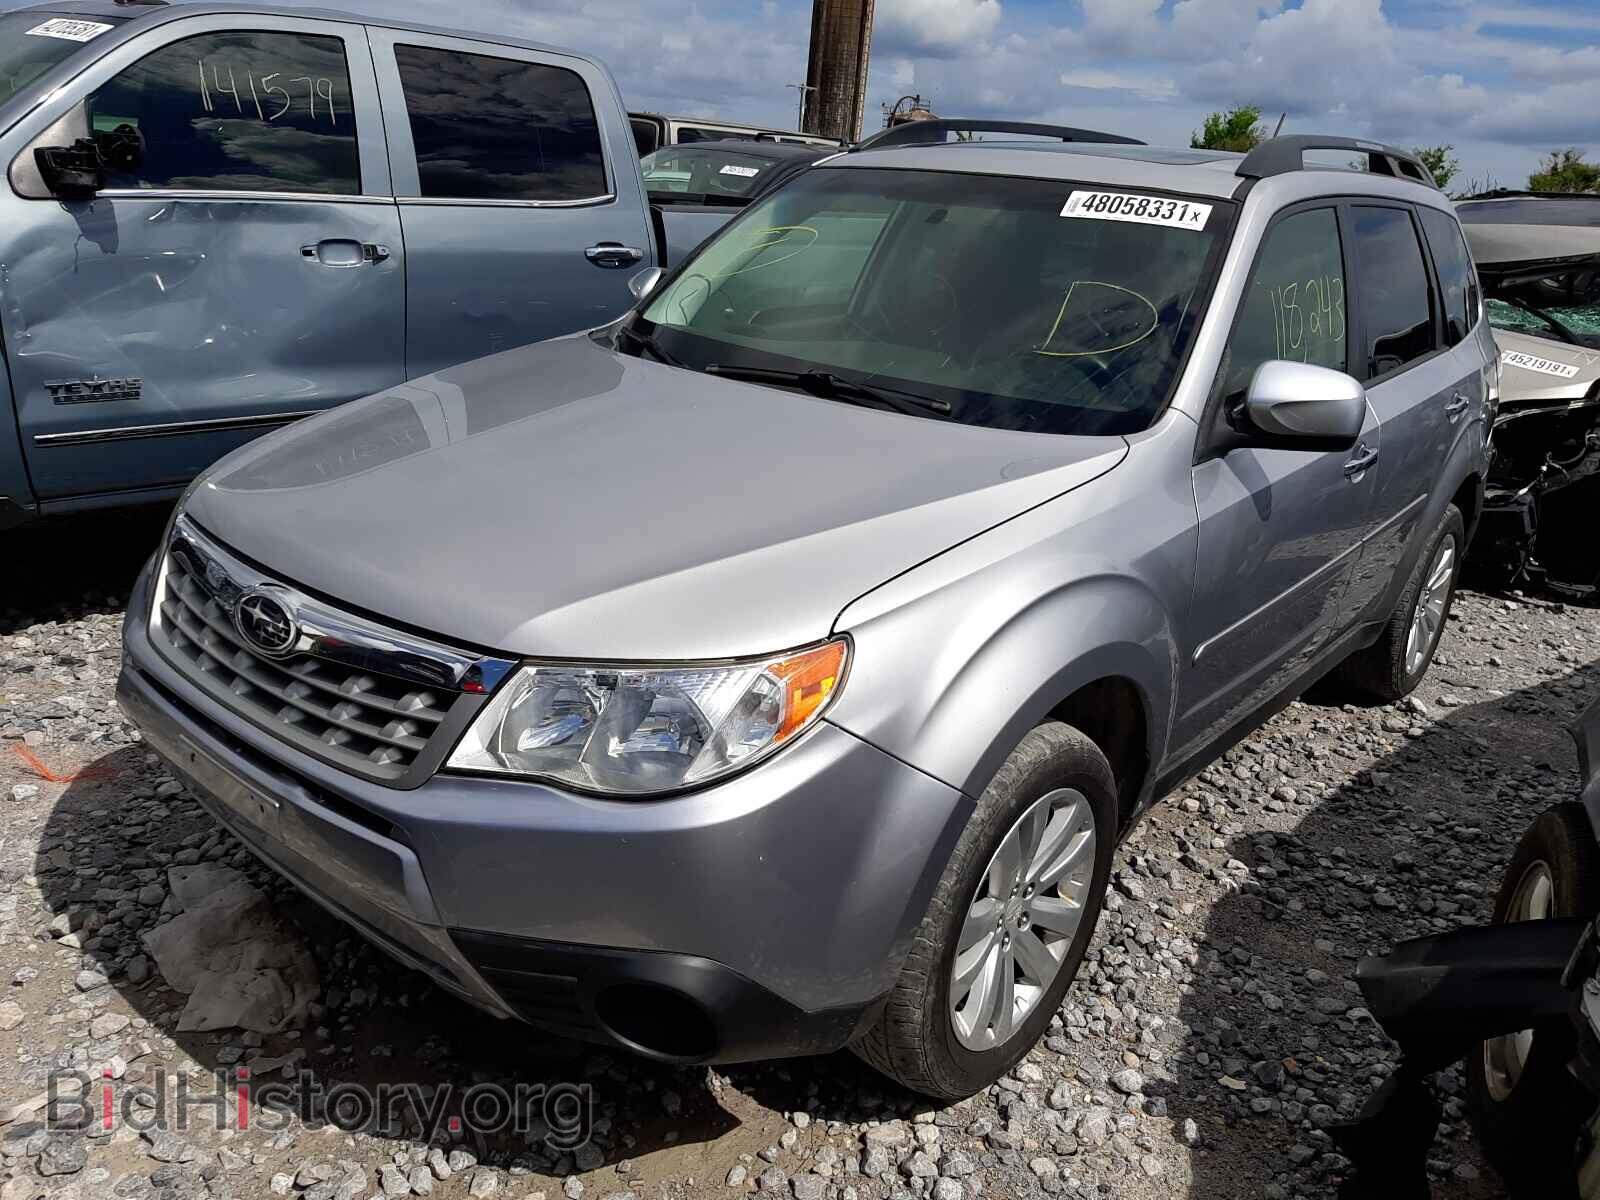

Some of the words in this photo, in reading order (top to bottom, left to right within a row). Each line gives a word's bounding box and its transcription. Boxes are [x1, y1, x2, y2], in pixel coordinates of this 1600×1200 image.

[198, 59, 336, 127] 141579
[1081, 194, 1190, 222] 48058331
[1509, 354, 1568, 374] 45219191
[44, 376, 144, 397] TEXAS
